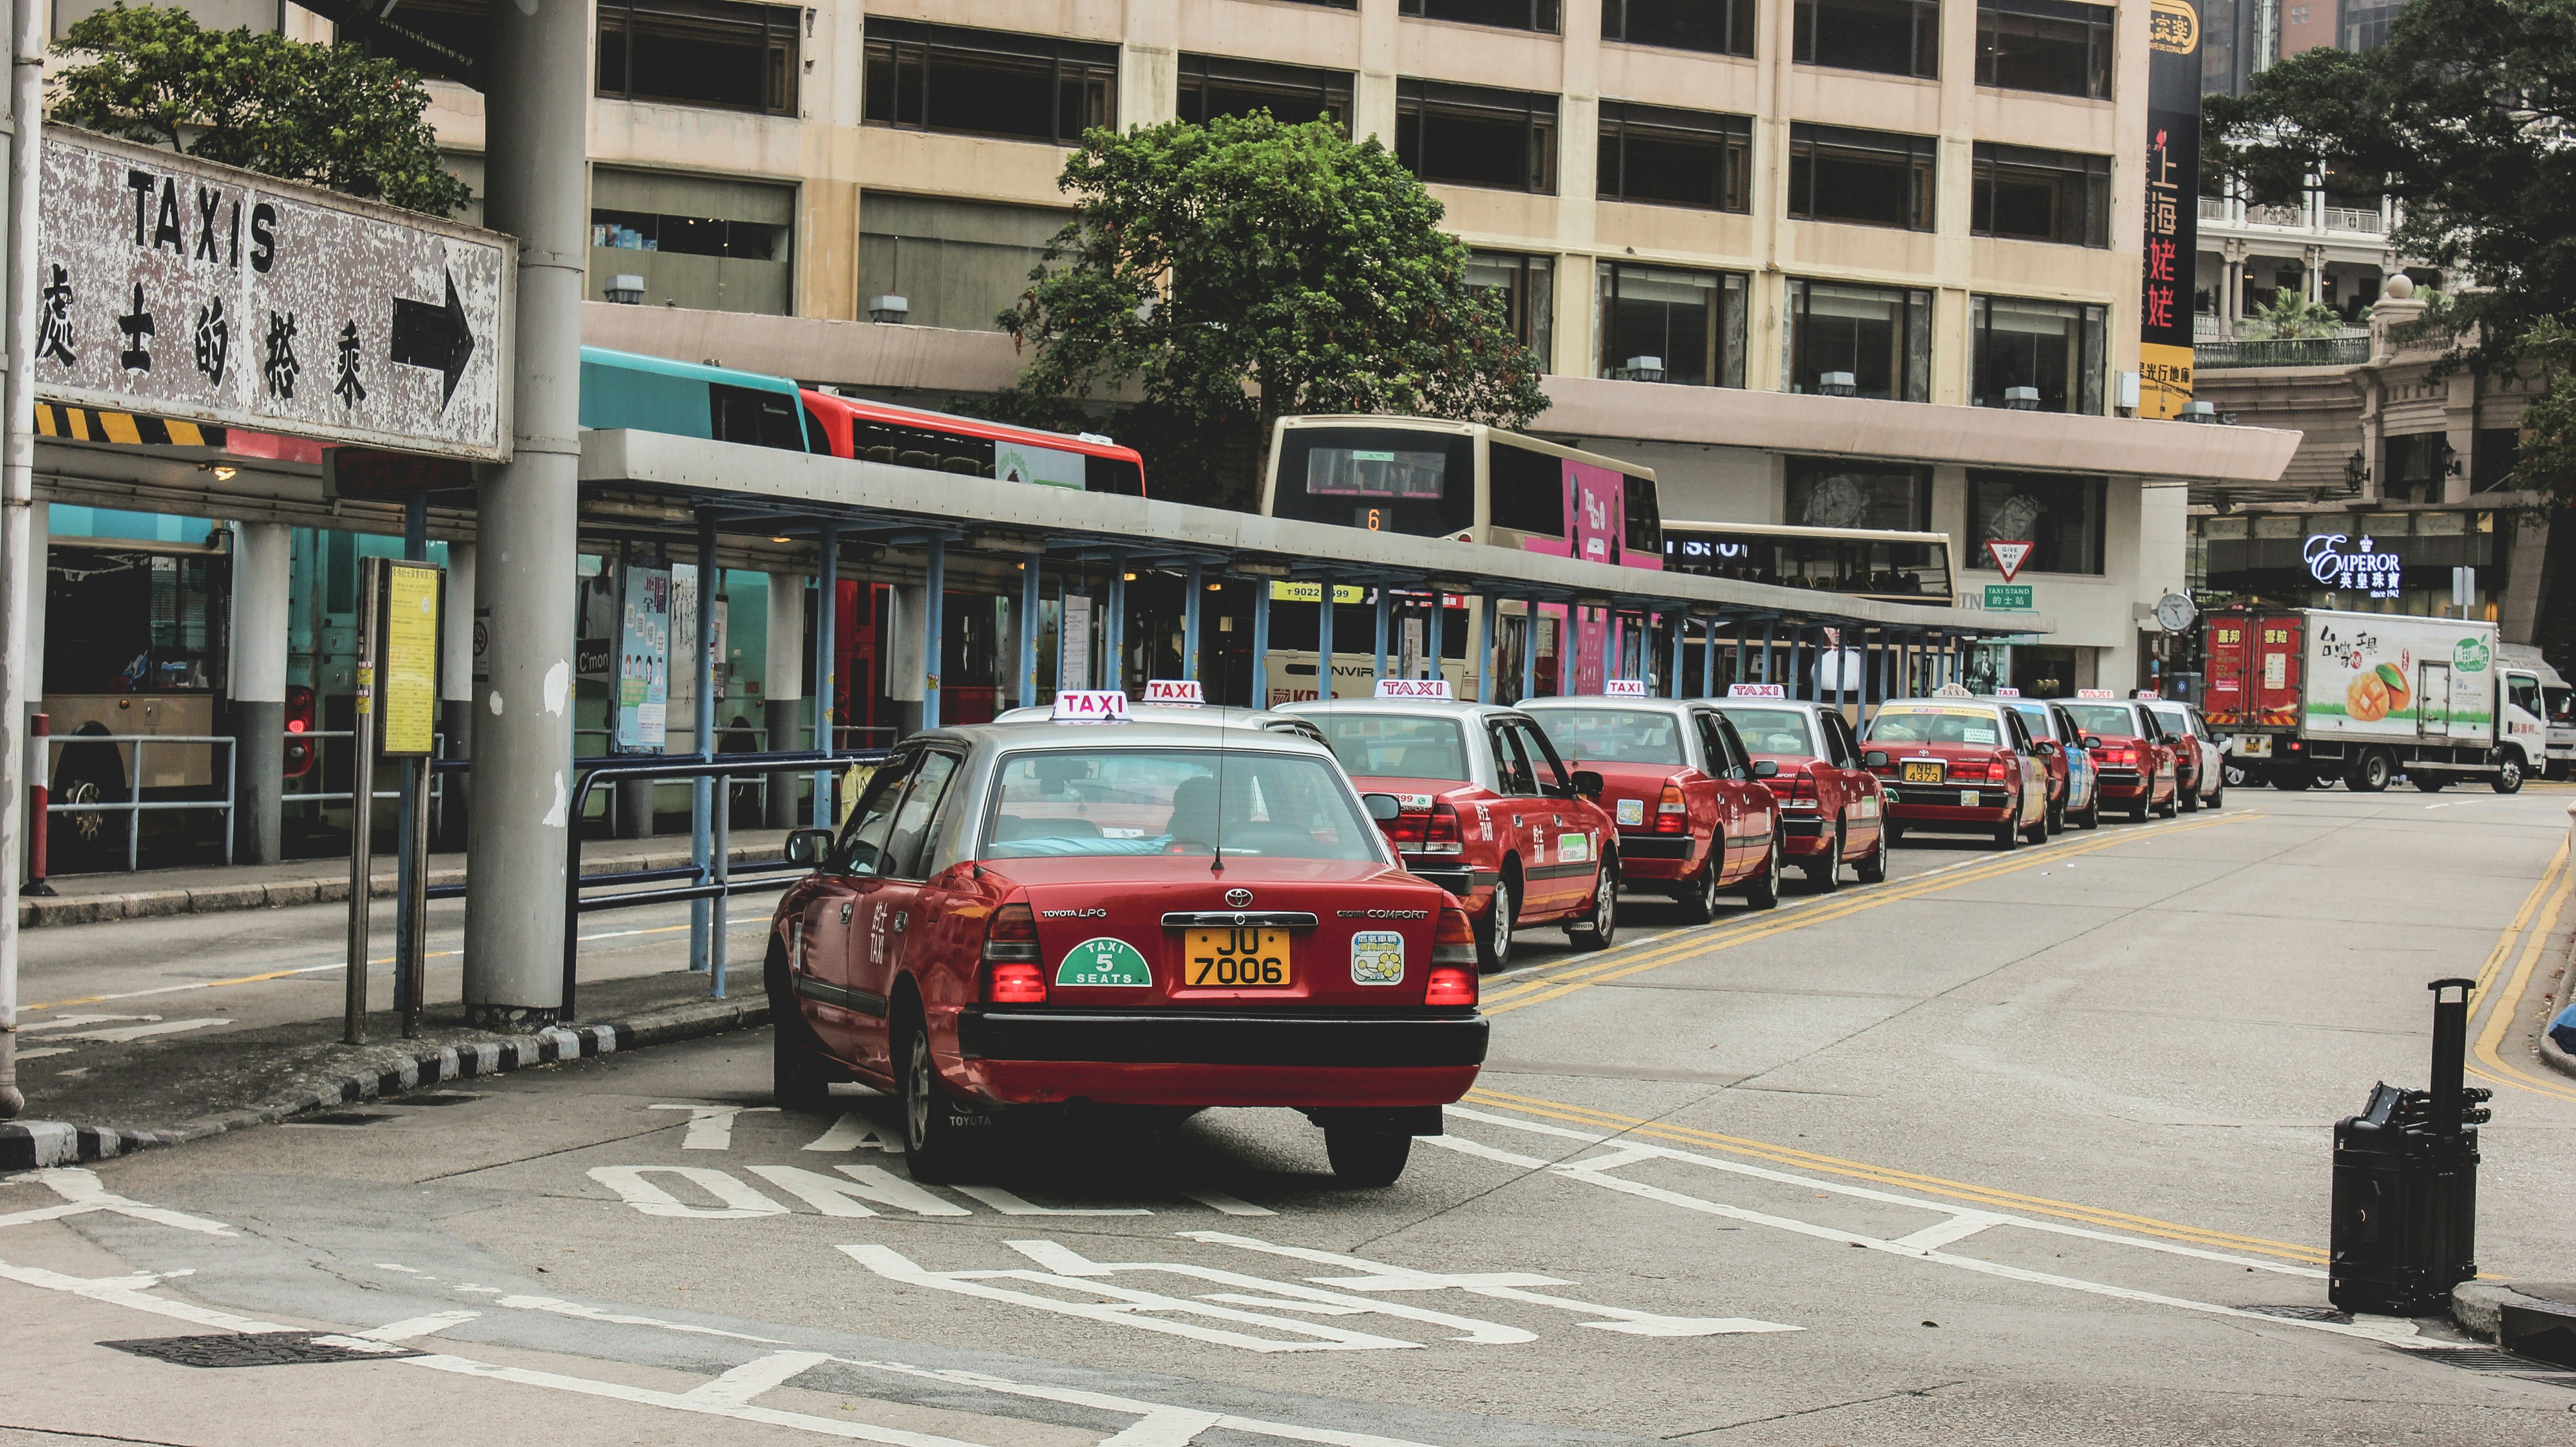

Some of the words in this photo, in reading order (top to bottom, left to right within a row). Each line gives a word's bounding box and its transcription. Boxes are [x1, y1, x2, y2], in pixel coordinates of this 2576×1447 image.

[129, 169, 277, 274] TAXIS
[2148, 146, 2178, 327] 上海姥姥
[1368, 509, 1380, 531] 6
[2304, 534, 2400, 584] EMPEROR
[2340, 571, 2400, 589] 英皇珠寶
[1294, 587, 1320, 597] 9022
[1993, 596, 2024, 605] 的士站
[580, 651, 609, 672] C'mon
[1150, 683, 1195, 698] TAXI
[1383, 682, 1443, 695] TAXI
[1611, 683, 1640, 692] TAXI
[1734, 686, 1779, 695] TAXI
[1064, 695, 1122, 713] TAXI
[1909, 773, 1938, 781] 4373
[1917, 764, 1932, 772] NH
[1479, 822, 1493, 841] TAXI
[1534, 844, 1544, 863] TAXI
[872, 902, 887, 932] 的士
[1079, 909, 1106, 917] LPG
[1367, 909, 1428, 919] COMFORT
[870, 933, 884, 964] TAXI
[1086, 941, 1124, 954] TAXI
[1217, 929, 1260, 956] JU
[1095, 954, 1113, 972] 5
[1194, 958, 1282, 984] 7006
[1076, 974, 1132, 983] SEATS
[949, 1116, 991, 1126] TOYOTA
